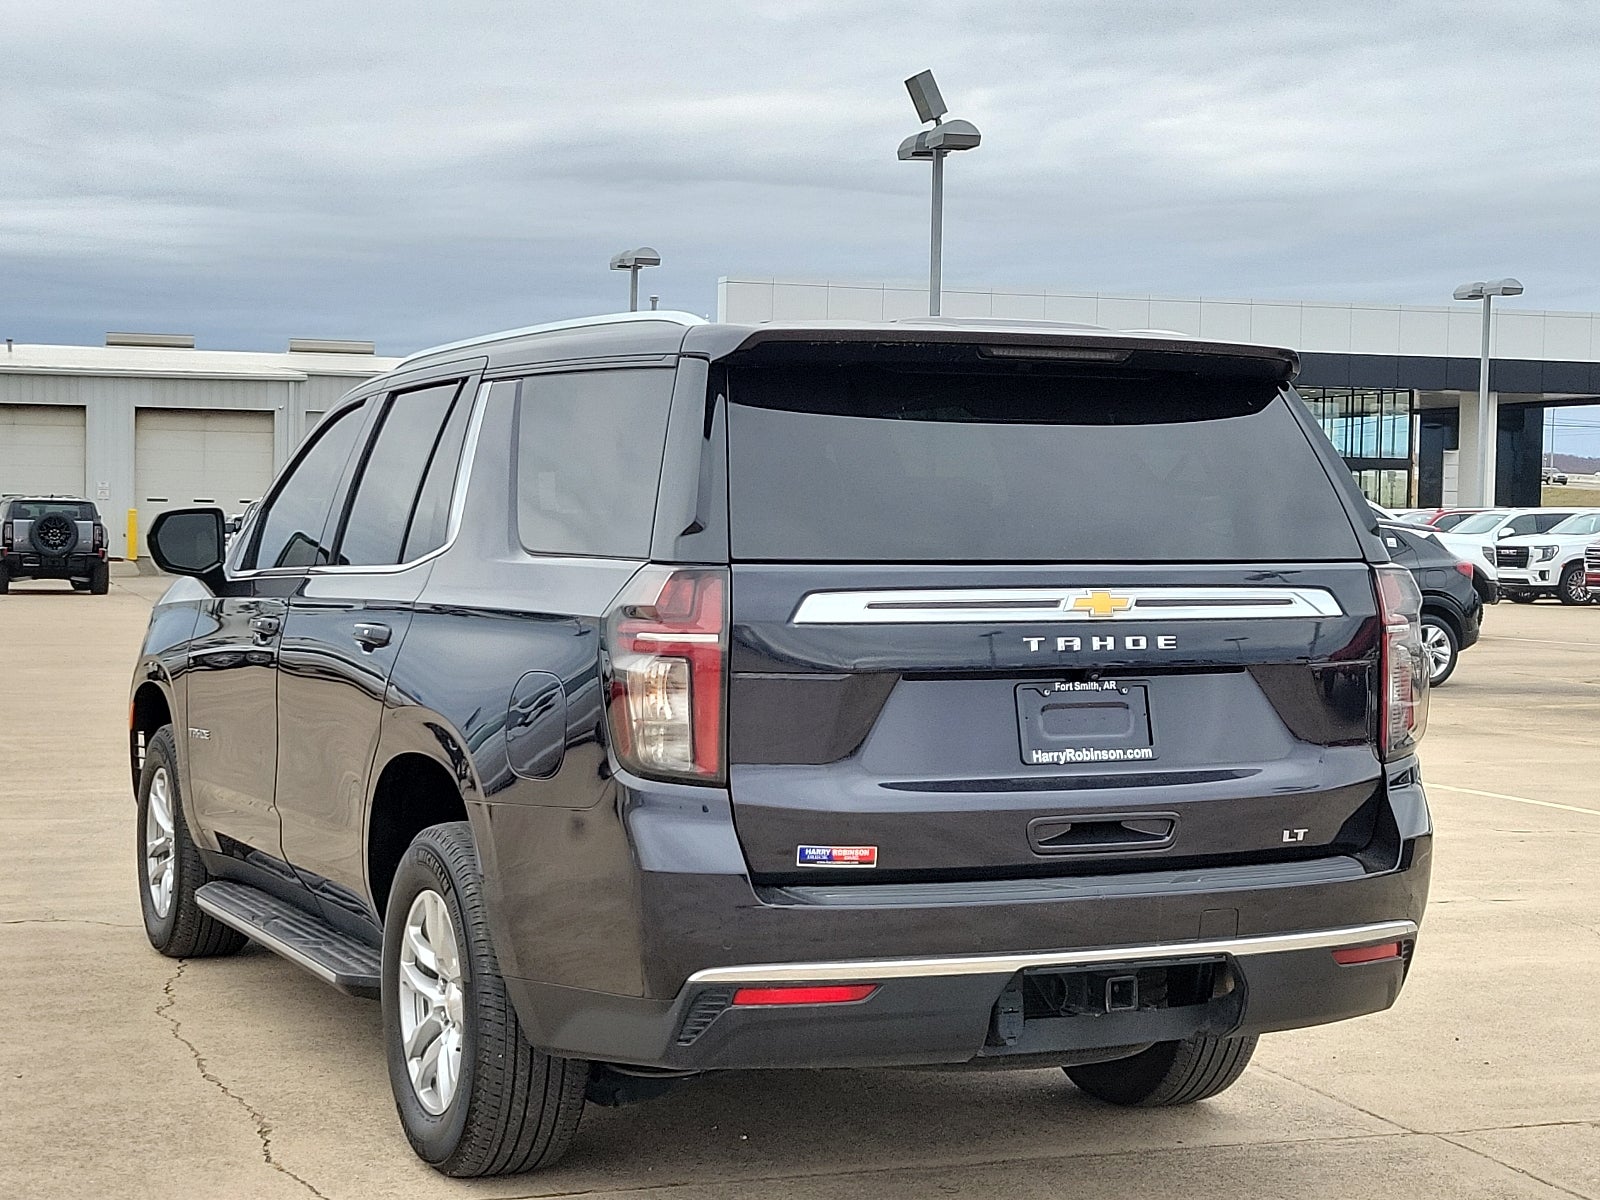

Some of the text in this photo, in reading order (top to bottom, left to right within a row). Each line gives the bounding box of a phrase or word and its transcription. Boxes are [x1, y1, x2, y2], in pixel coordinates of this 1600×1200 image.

[1022, 635, 1177, 652] TAHOE
[1055, 680, 1117, 692] Fort Smith, AR
[1032, 747, 1153, 765] HarryRobinson.com
[1282, 828, 1309, 842] LT
[805, 848, 870, 856] HARRY ROBINSON
